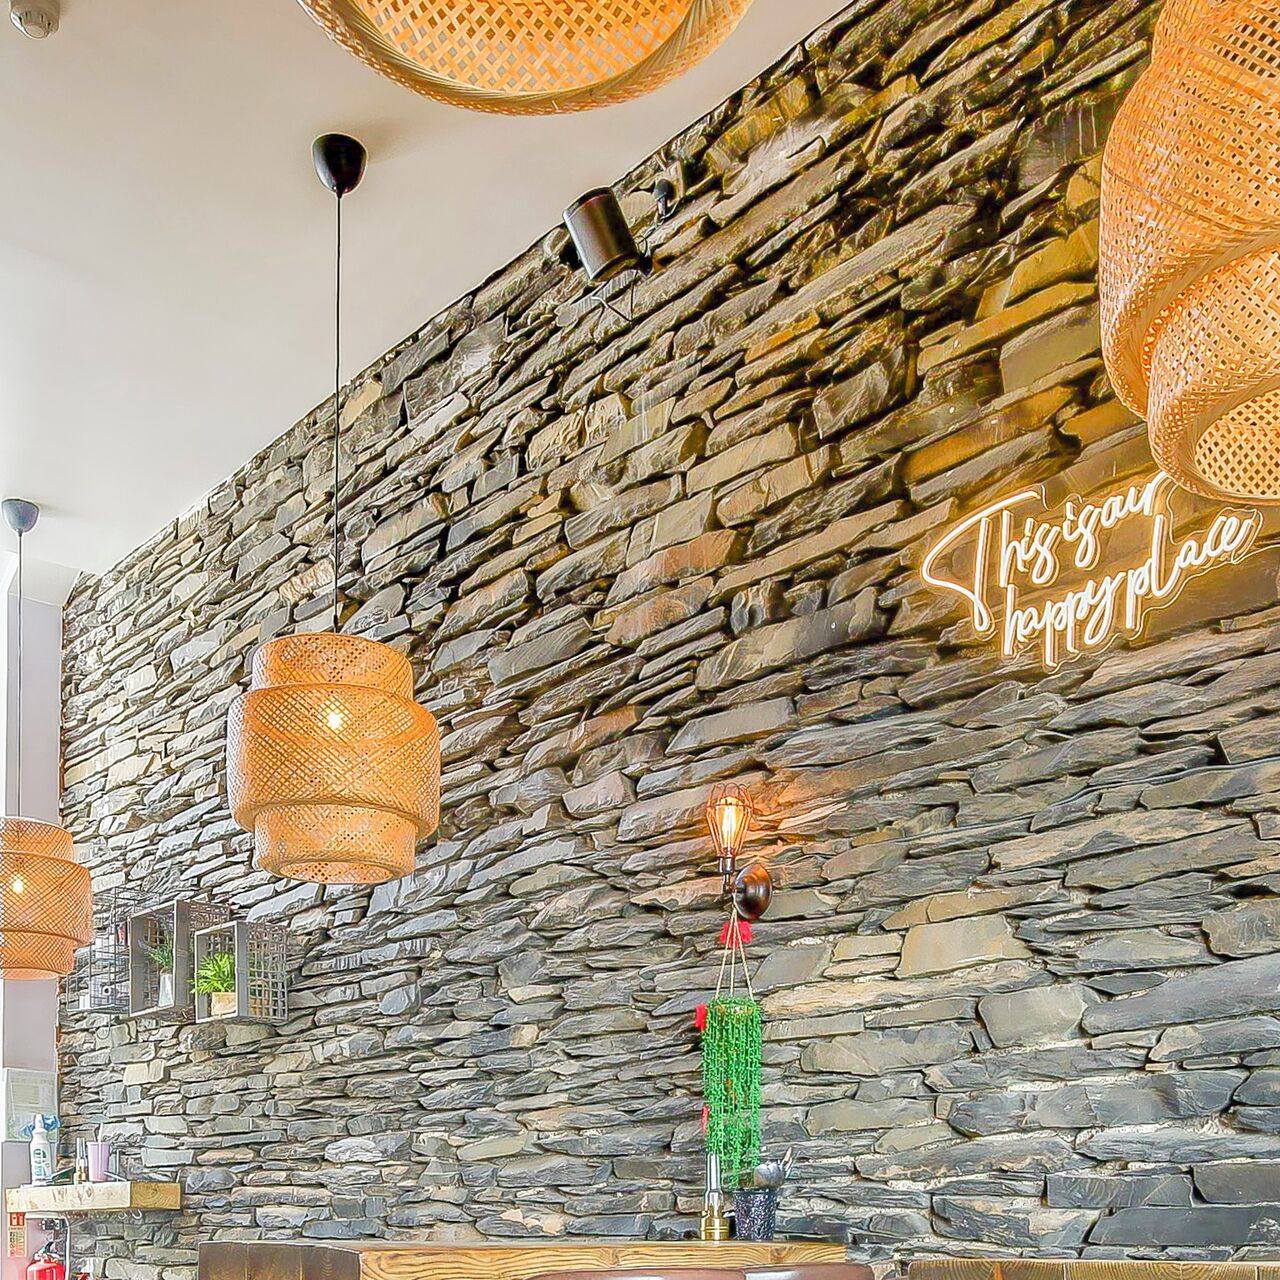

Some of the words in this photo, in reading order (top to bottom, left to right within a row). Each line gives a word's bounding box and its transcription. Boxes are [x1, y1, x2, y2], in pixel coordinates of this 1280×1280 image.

[921, 490, 1060, 632] This
[1063, 501, 1102, 569] is
[1101, 470, 1168, 529] our
[1004, 572, 1124, 667] happy
[1126, 513, 1257, 629] place
